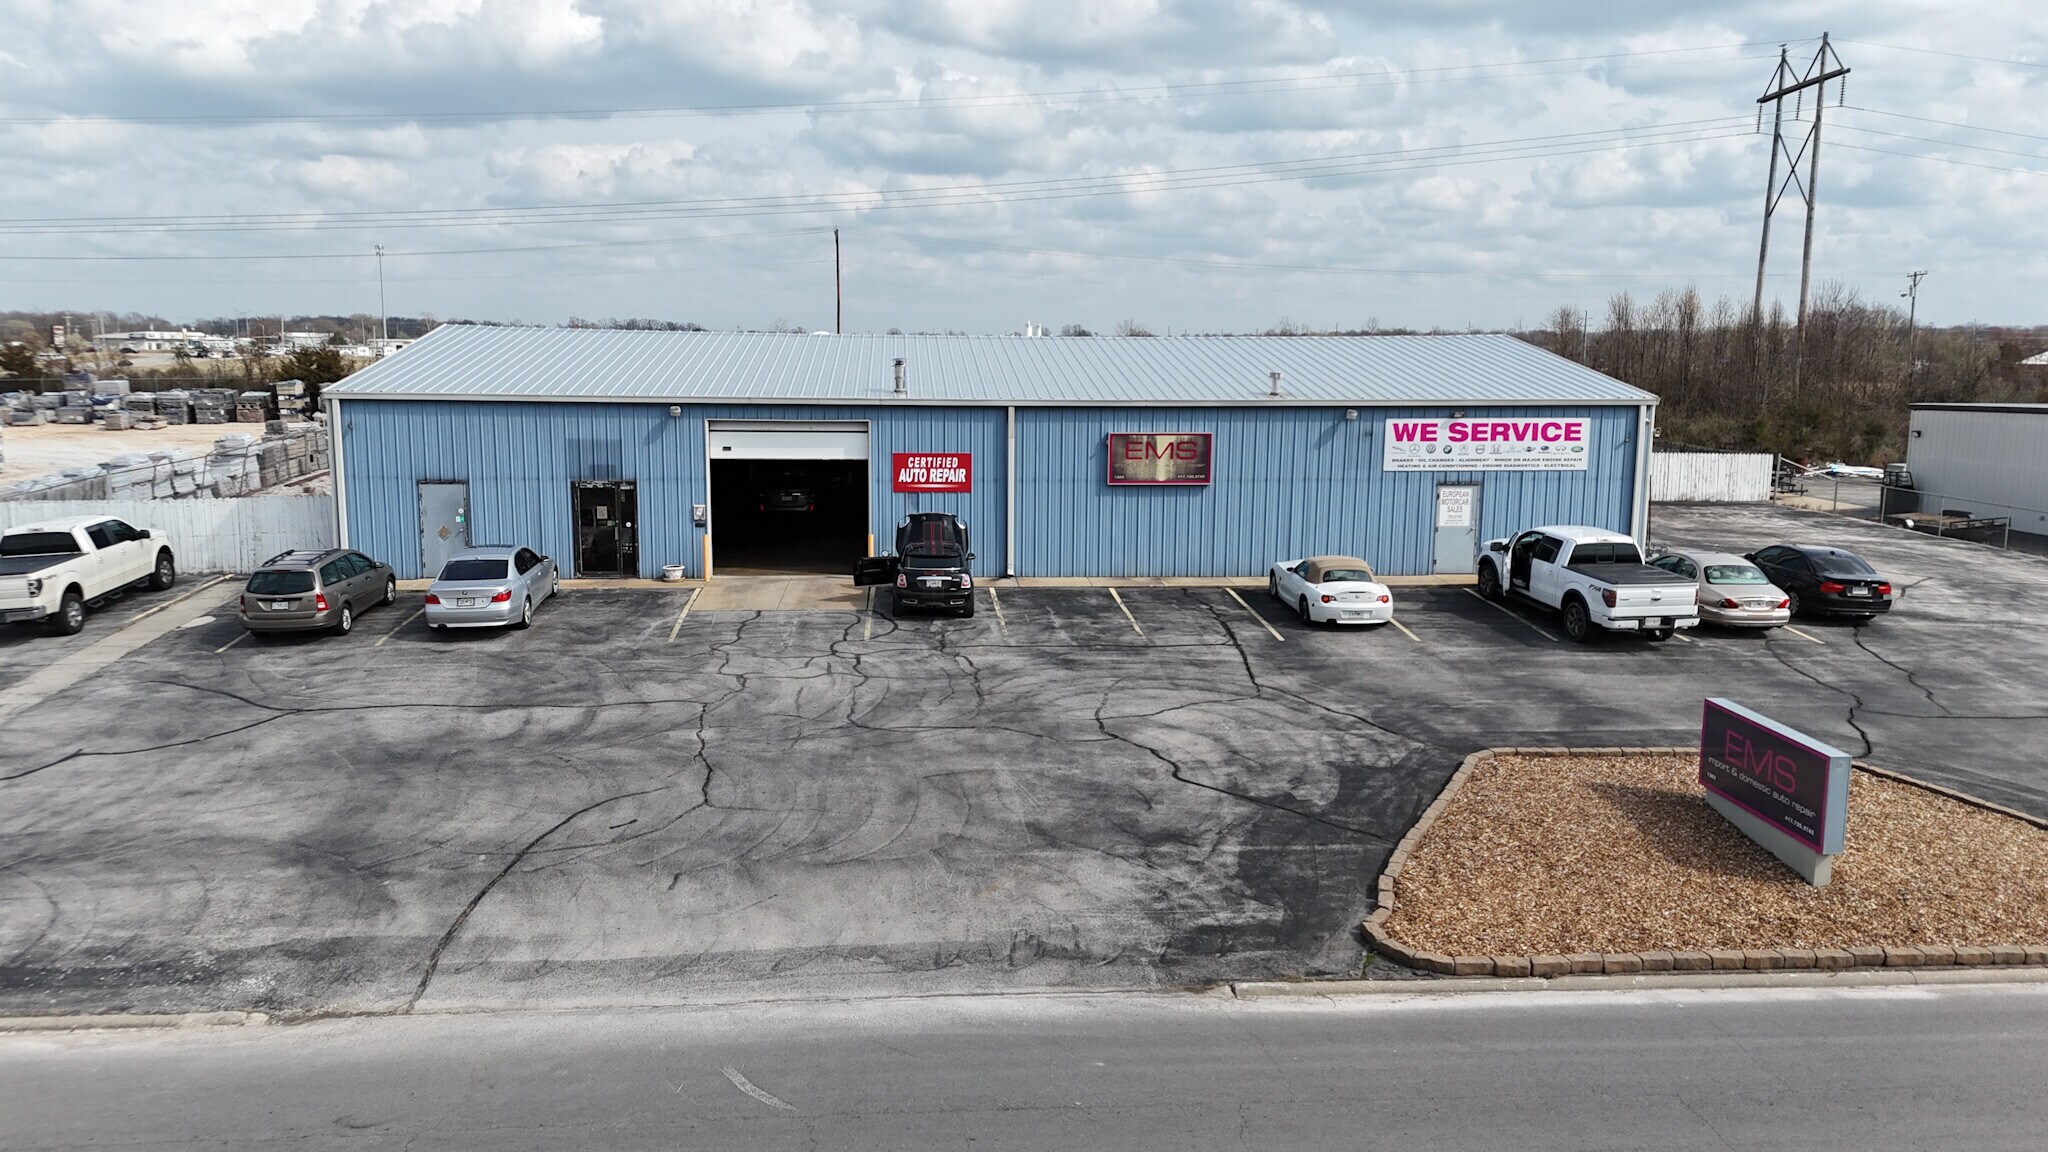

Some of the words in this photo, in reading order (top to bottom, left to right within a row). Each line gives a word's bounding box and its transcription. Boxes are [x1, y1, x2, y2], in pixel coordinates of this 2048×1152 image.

[1393, 423, 1438, 442] WE
[1448, 422, 1582, 442] SERVICE
[1124, 441, 1199, 461] EMS
[908, 457, 959, 468] CERTIFIED
[898, 468, 927, 483] AUTO
[929, 468, 966, 483] REPAIR
[1441, 498, 1469, 506] MOTORCAR
[1442, 490, 1469, 498] EUROPEAN
[1725, 729, 1797, 793] EMS
[1708, 756, 1731, 774] import
[1731, 767, 1738, 777] &
[1738, 772, 1771, 796] domestic
[1772, 790, 1791, 806] auto
[1791, 800, 1816, 818] repair
